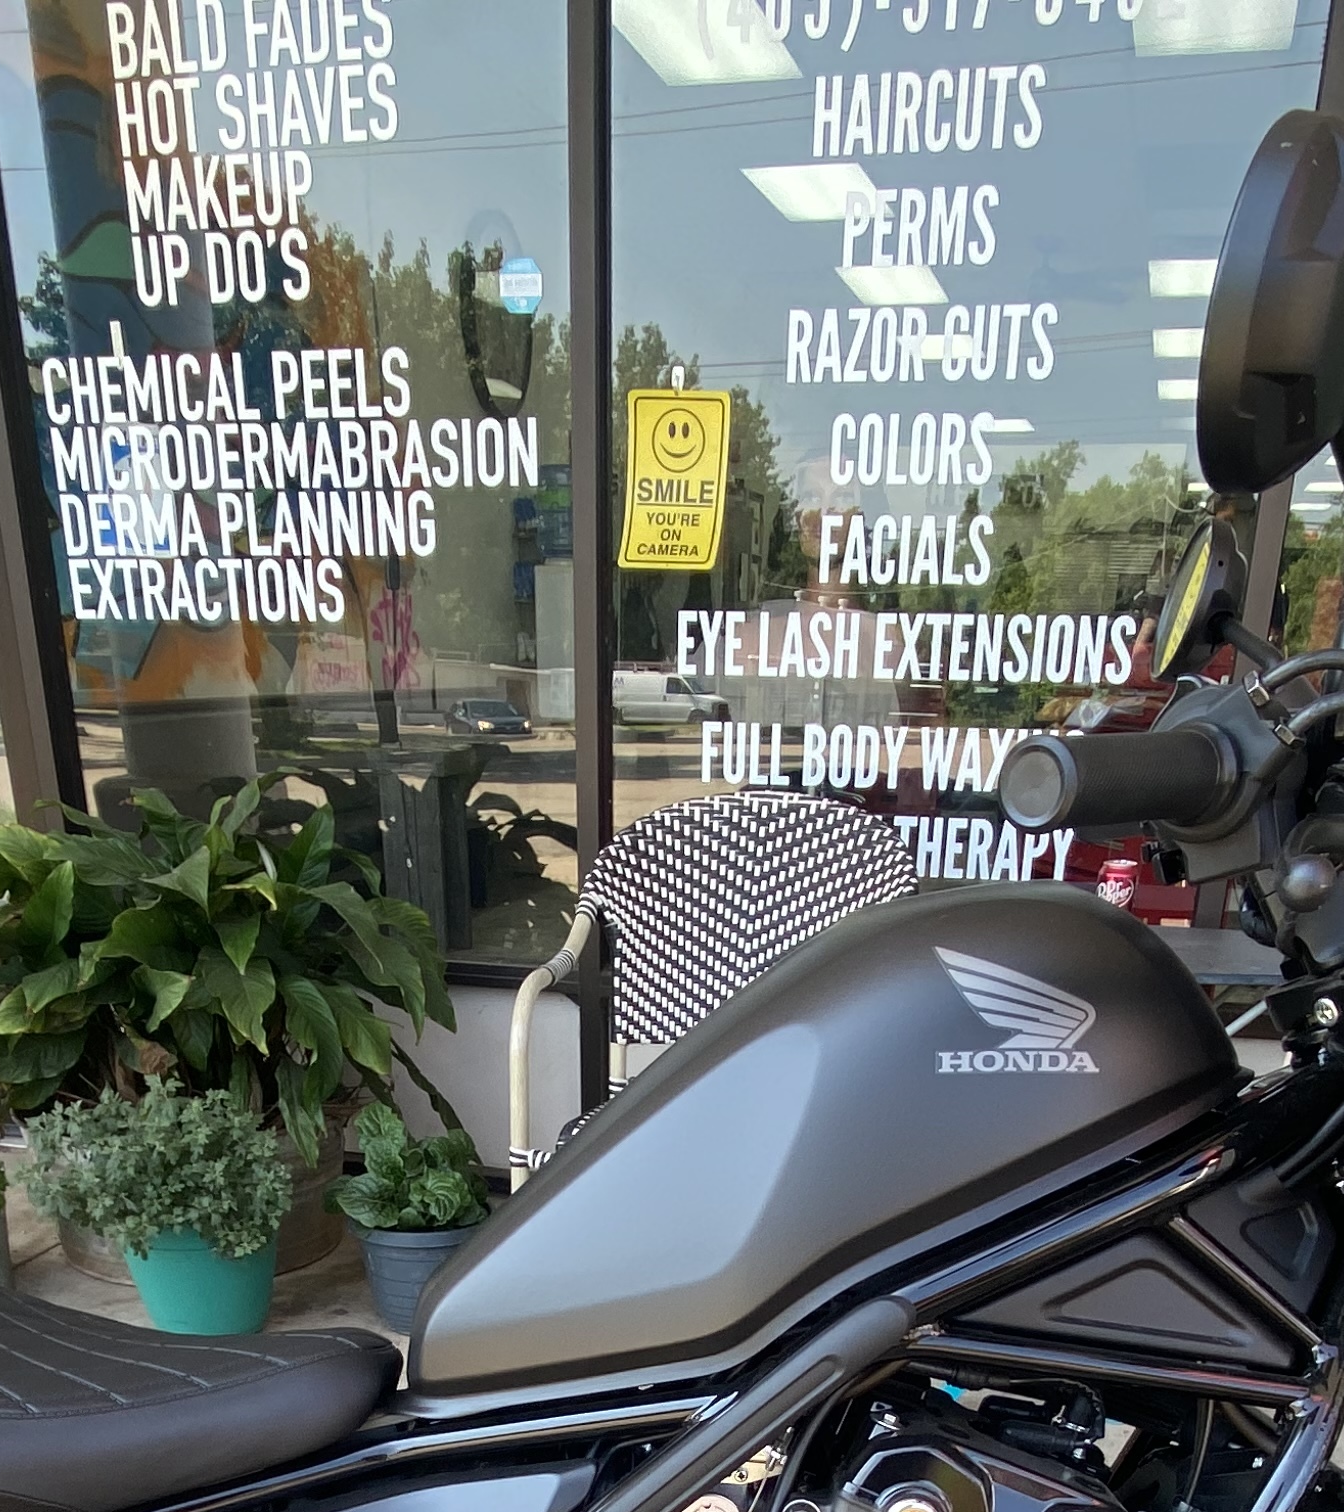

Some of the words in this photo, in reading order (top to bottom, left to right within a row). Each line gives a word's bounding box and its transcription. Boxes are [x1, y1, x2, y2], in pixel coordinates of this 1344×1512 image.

[106, 0, 227, 79] BALD
[243, 0, 394, 68] FADES
[115, 79, 200, 158] HOT
[217, 62, 399, 153] SHAVES
[812, 64, 1049, 158] HAIRCUTS
[123, 151, 314, 233] MAKEUP
[841, 185, 1000, 268] PERMS
[131, 233, 190, 307] UP
[206, 228, 311, 303] DO'S
[786, 306, 928, 384] RAZOR
[943, 302, 1058, 382] CUTS
[42, 351, 260, 424] CHEMICAL
[271, 346, 411, 420] PEELS
[49, 417, 539, 491] MICRODERMABRASION
[829, 412, 994, 487] COLORS
[58, 493, 205, 558] DERMA
[219, 490, 437, 557] PLANNING
[637, 478, 715, 504] SMILE
[646, 512, 701, 527] YOU'RE
[637, 543, 699, 556] CAMERA
[660, 529, 682, 541] ON
[817, 514, 995, 587] FACIALS
[68, 558, 346, 622] EXTRACTIONS
[676, 610, 745, 677] EYE
[757, 611, 859, 680] LASH
[873, 613, 1138, 686] EXTENSIONS
[701, 721, 791, 787] FULL
[801, 723, 908, 790] BODY
[921, 727, 1085, 793] WAX
[893, 815, 1075, 882] THERAPY
[938, 1051, 1100, 1073] HONDA
